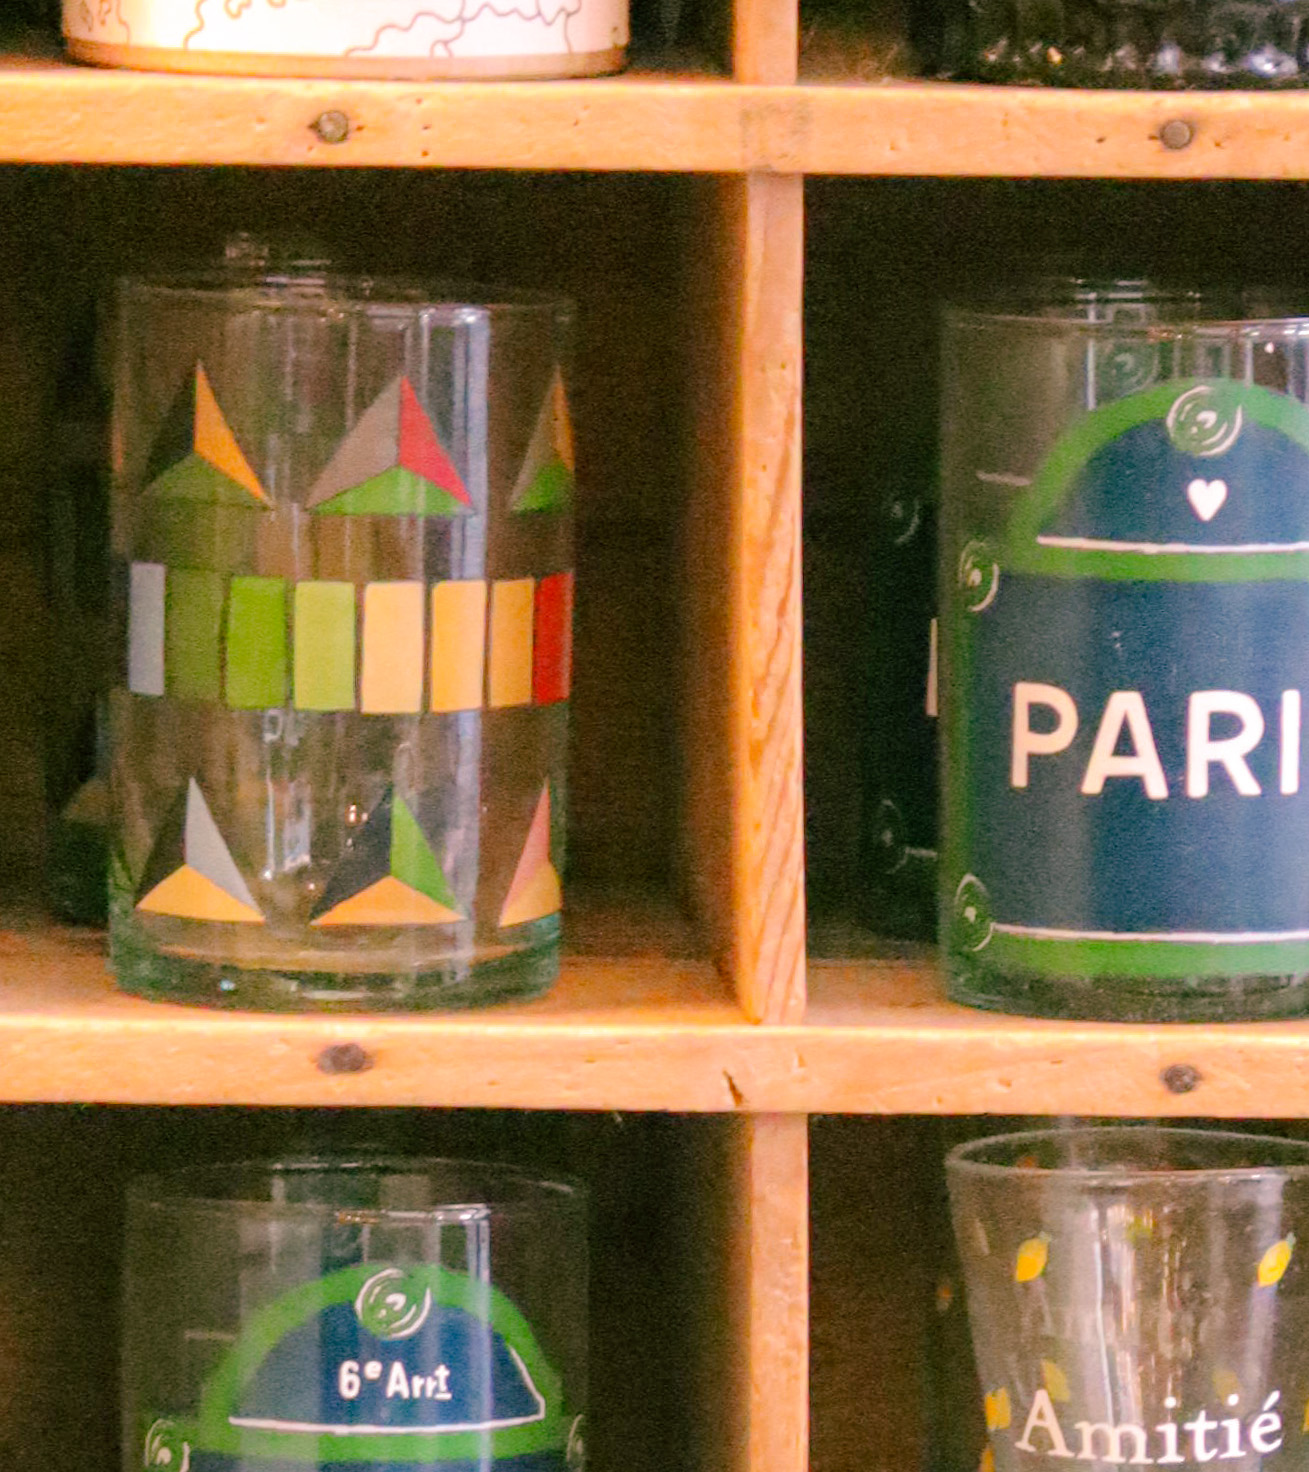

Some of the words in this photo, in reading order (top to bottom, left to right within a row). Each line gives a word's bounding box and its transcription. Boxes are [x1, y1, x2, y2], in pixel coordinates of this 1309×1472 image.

[338, 1359, 382, 1400] 6e
[385, 1360, 453, 1401] Arrt
[1014, 1388, 1284, 1465] Amitié
